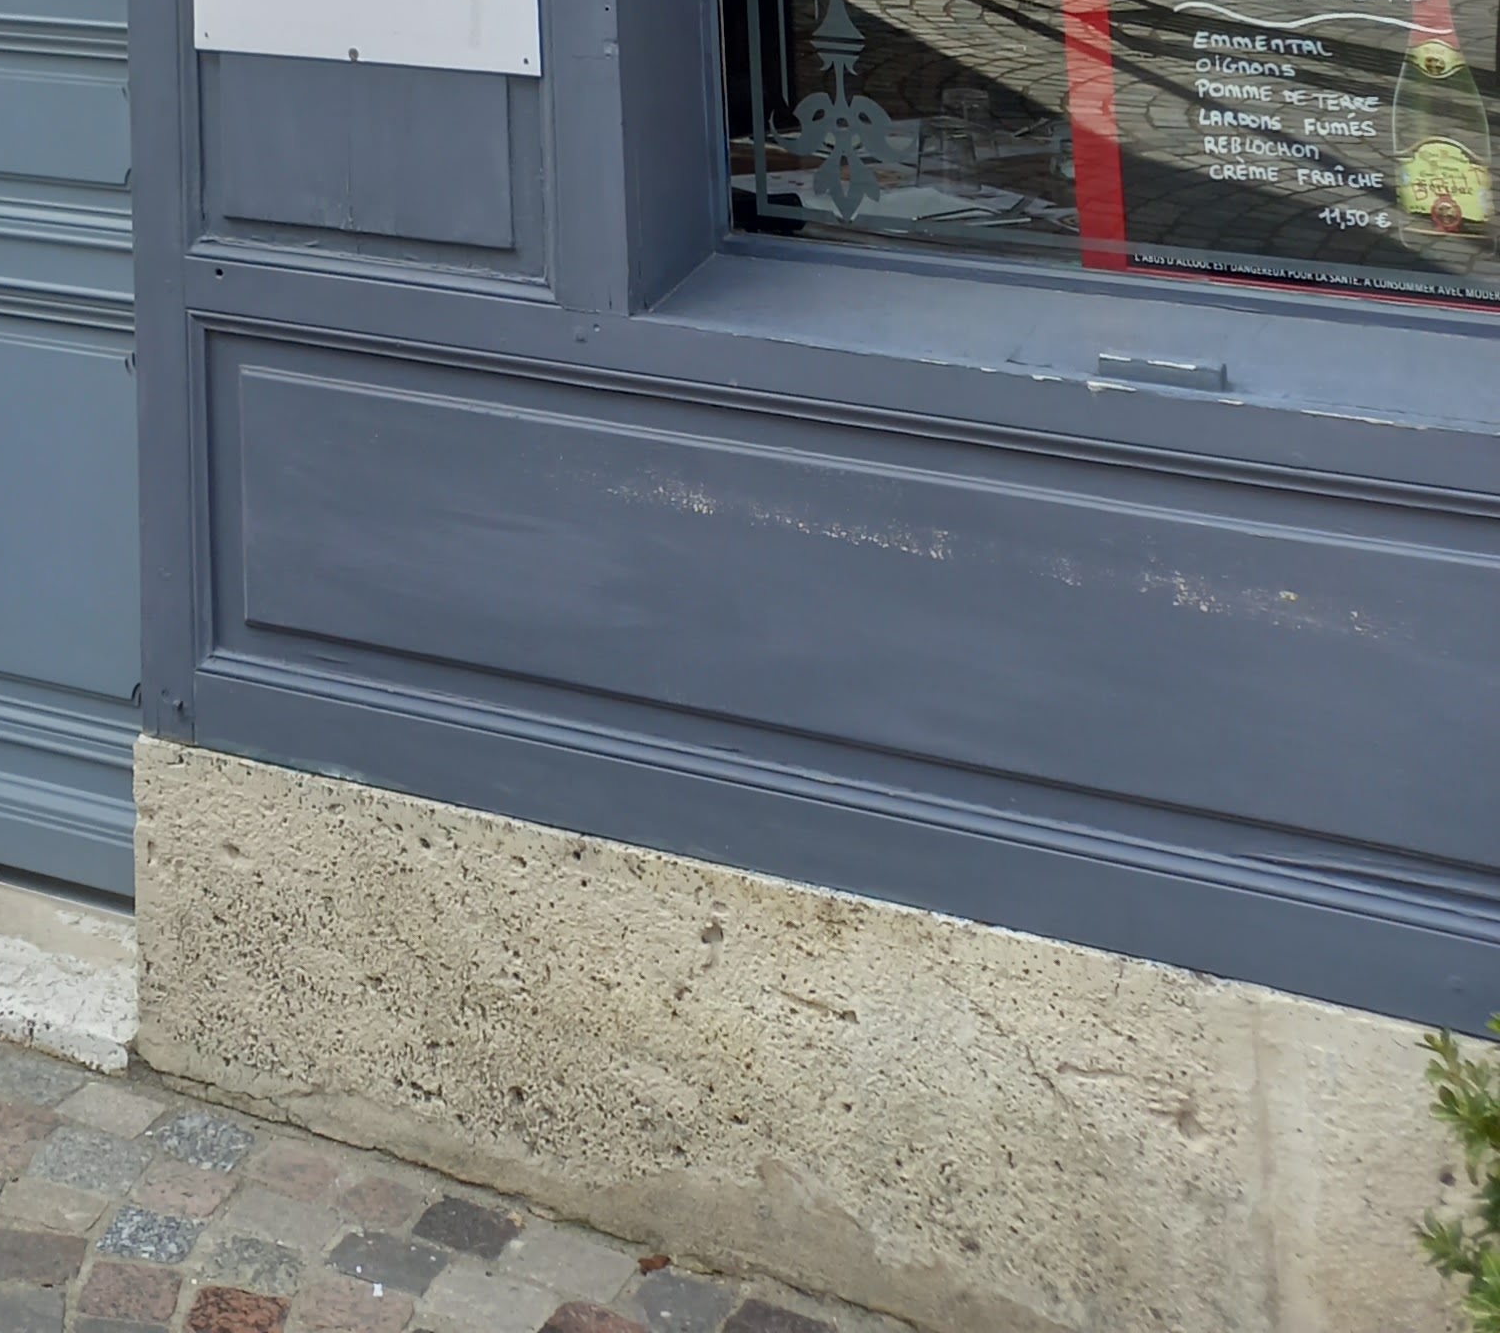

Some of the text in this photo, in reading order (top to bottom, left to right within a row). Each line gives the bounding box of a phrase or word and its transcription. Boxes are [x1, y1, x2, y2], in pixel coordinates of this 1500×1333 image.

[1282, 89, 1308, 106] DE
[1312, 93, 1381, 113] TERRE
[1303, 112, 1378, 137] FUMÉS
[1208, 155, 1385, 189] CRÈME FRAÎCHE
[1318, 208, 1392, 230] 11,50 €
[1314, 273, 1328, 282] LA
[1438, 285, 1464, 298] AVEC
